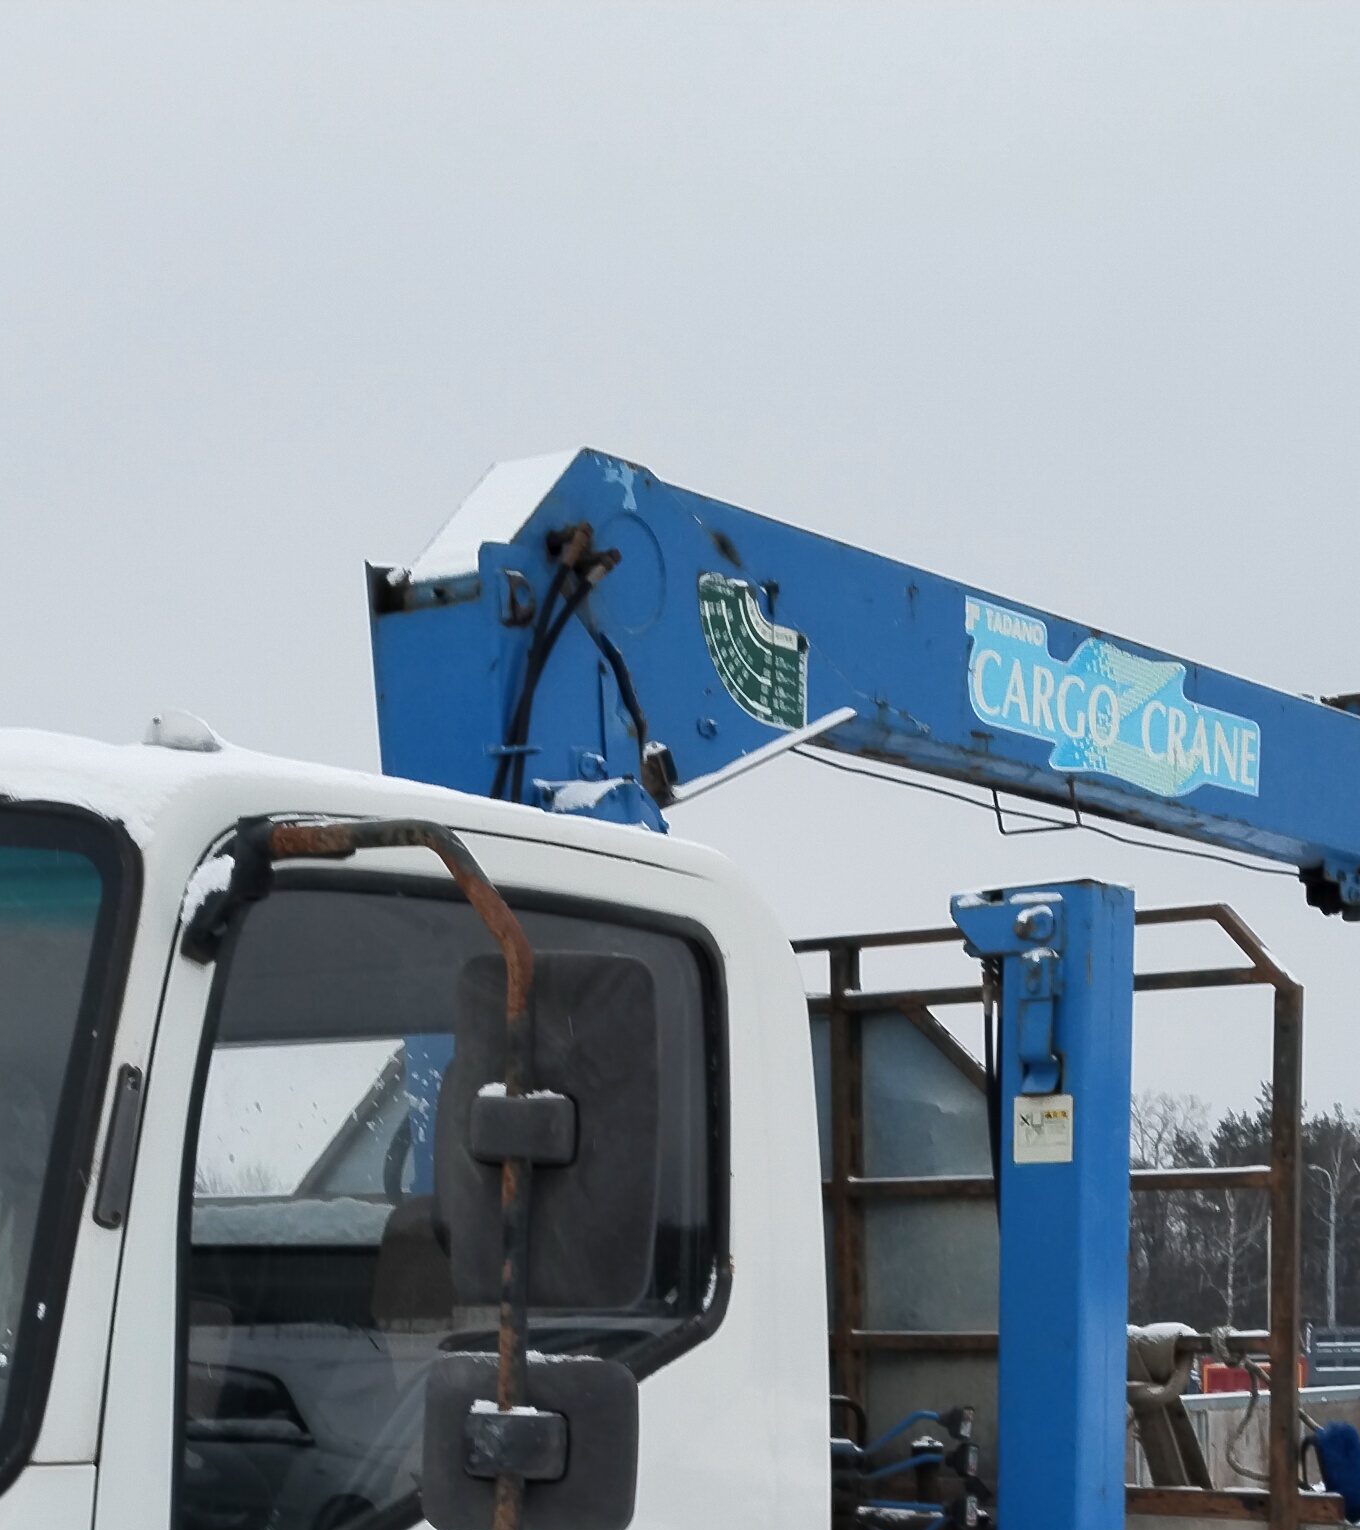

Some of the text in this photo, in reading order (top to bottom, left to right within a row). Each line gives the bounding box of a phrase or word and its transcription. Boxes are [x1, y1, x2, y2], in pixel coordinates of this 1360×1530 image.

[986, 608, 1044, 646] TADANO
[974, 650, 1257, 786] CARGO CRANE
